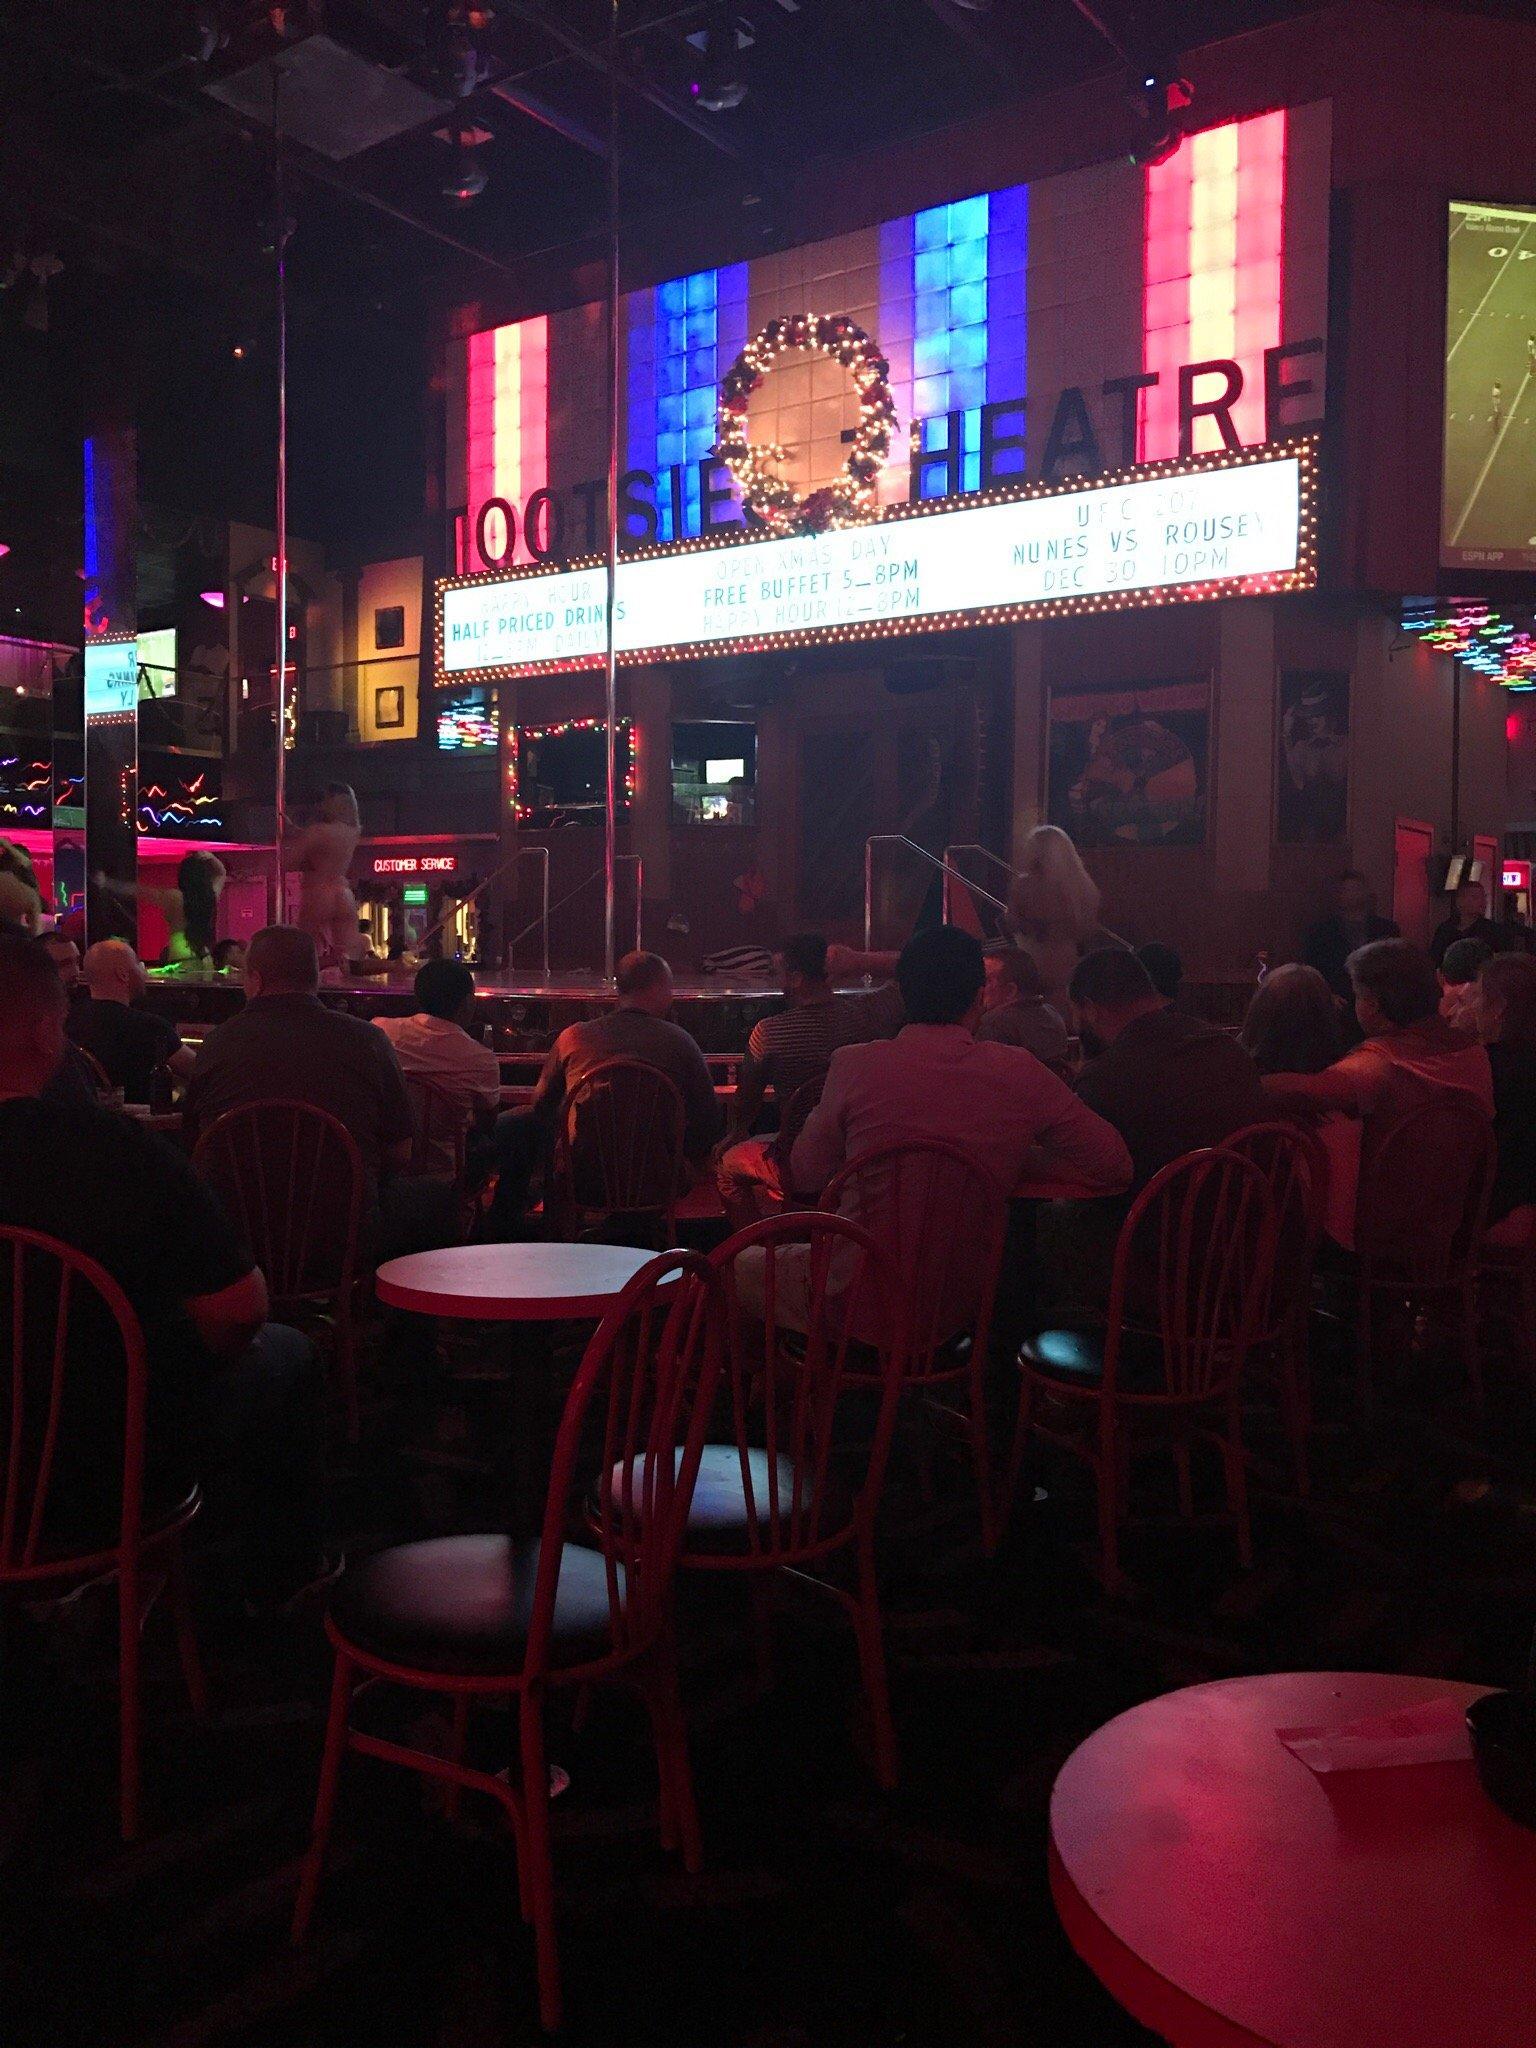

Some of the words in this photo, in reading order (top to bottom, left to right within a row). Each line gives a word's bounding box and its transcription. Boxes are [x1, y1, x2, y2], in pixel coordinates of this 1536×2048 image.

[848, 336, 1324, 503] HEATRE
[716, 555, 765, 581] OPEN
[851, 534, 893, 561] DAY
[1012, 534, 1090, 566] NUNES
[1109, 528, 1139, 553] VS
[1043, 565, 1085, 591] DEC
[1104, 559, 1136, 584] 30
[1162, 545, 1229, 576] 10PM
[703, 583, 748, 608] FREE
[760, 572, 832, 601] BUFFET
[451, 619, 490, 642] HALF
[497, 610, 555, 635] PRICED
[564, 600, 626, 628] DRINS
[775, 599, 828, 625] HOUR
[374, 858, 417, 873] CUSTOMER
[420, 857, 455, 871] SERVICE
